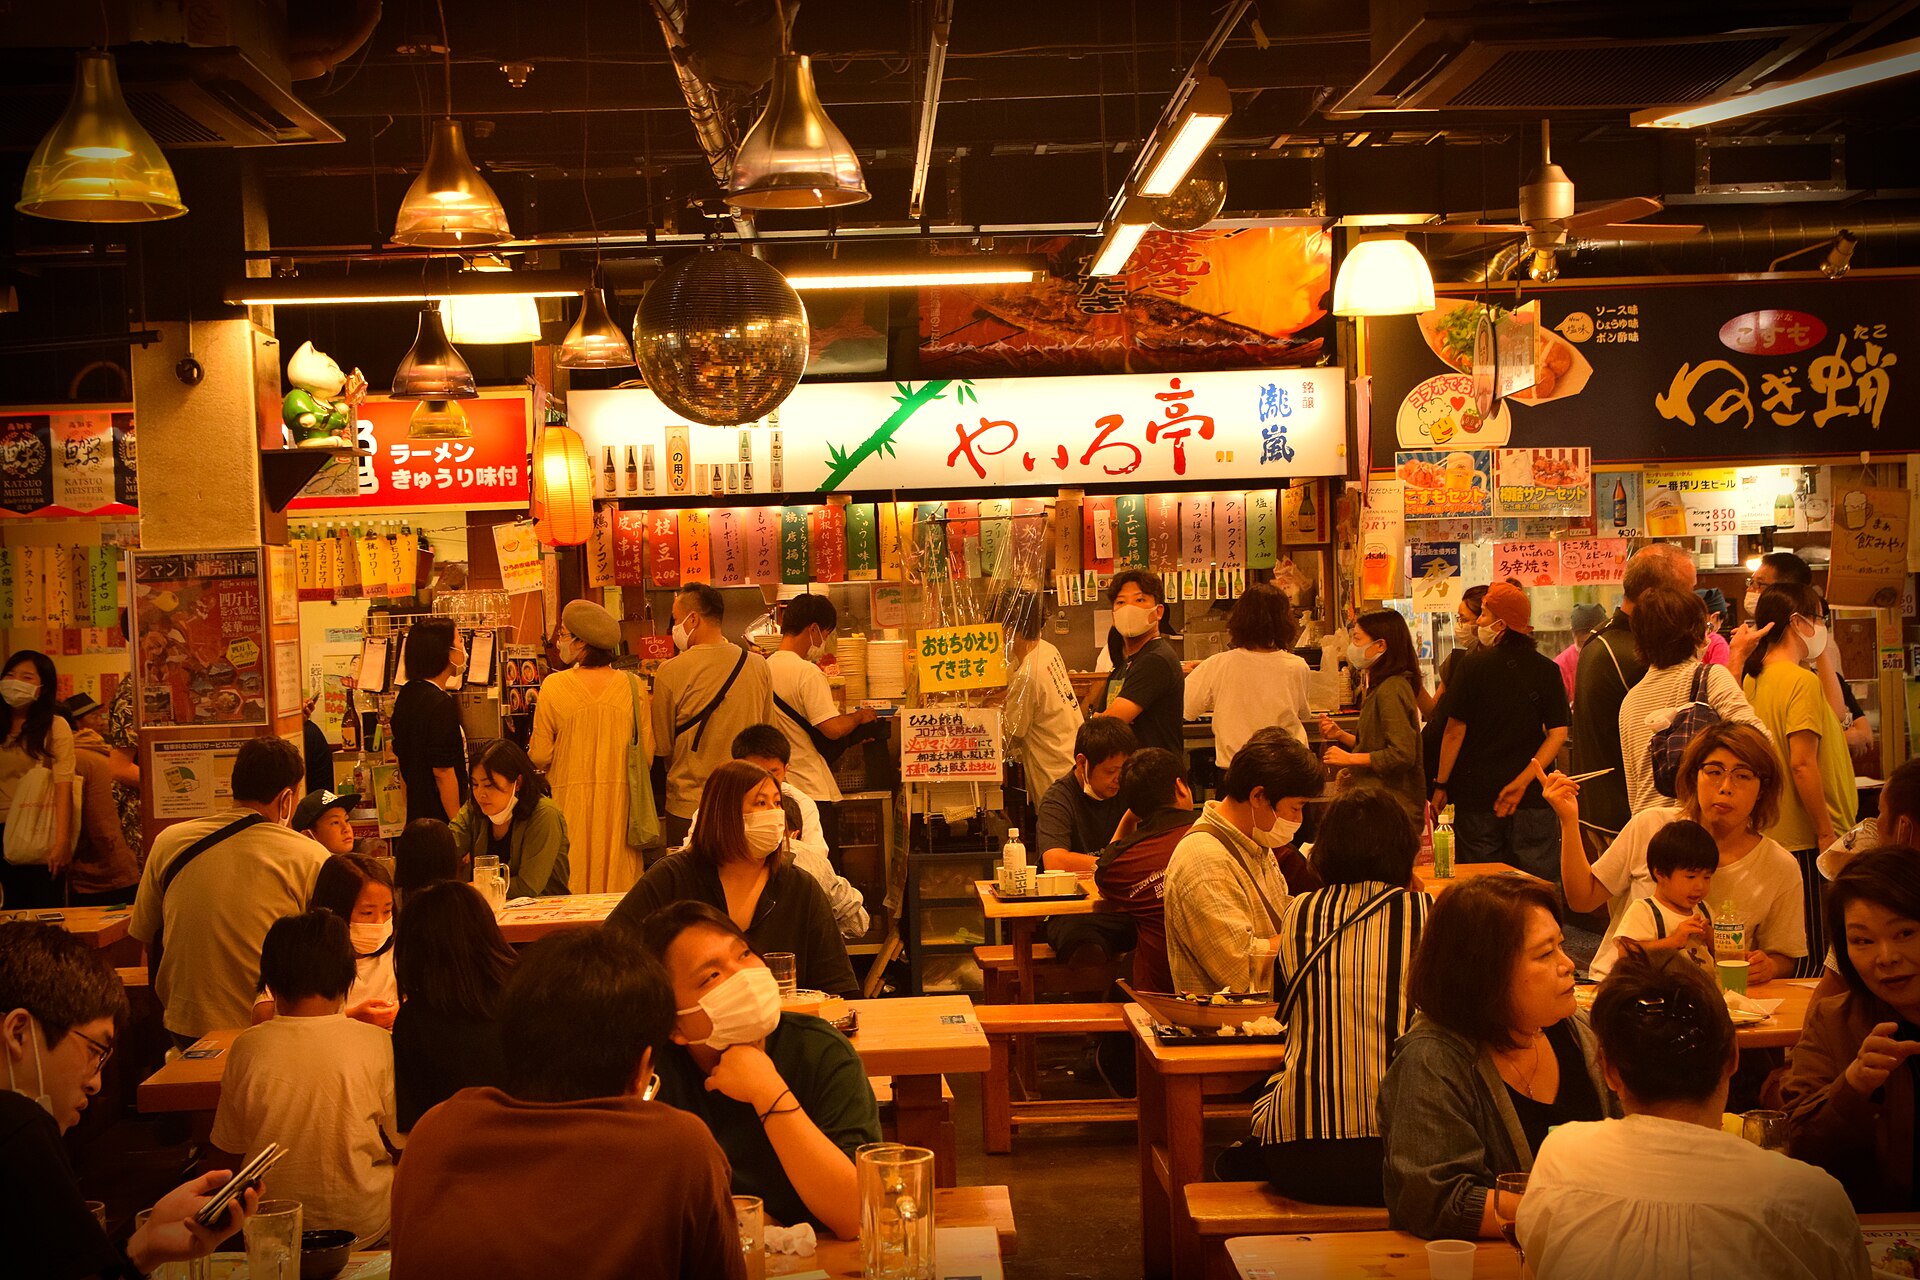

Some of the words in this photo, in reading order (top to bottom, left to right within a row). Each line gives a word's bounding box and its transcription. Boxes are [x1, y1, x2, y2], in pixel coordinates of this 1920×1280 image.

[1595, 305, 1639, 316] ソース味
[1595, 318, 1640, 330] しょうゆ味
[1853, 324, 1888, 340] たこ
[1596, 331, 1640, 343] ポン酢味
[1736, 326, 1810, 349] こすも
[1408, 375, 1476, 410] コラボでお
[947, 377, 1215, 480] やいろ亭
[390, 442, 475, 465] ラーメン
[3, 479, 43, 488] KATSUO
[64, 477, 103, 486] KATSUO
[391, 465, 519, 490] きゅうり味付
[1658, 479, 1736, 492] 一番搾り生ビール
[3, 488, 44, 496] MEISTER
[64, 486, 104, 495] MEISTER
[1404, 487, 1486, 505] こすもセット
[1499, 486, 1586, 503] 樽詰サワーセット
[1711, 509, 1736, 519] 850
[1226, 501, 1237, 560] タレタタキ
[1255, 498, 1267, 549] 塩タタキ
[1712, 520, 1736, 531] 550
[617, 514, 632, 557] 皮串
[653, 518, 674, 563] 枝豆
[687, 512, 702, 562] 焼きそば
[720, 512, 736, 573] マーボー豆腐
[1503, 544, 1536, 553] しあわせ
[1563, 540, 1599, 551] たこ焼き
[136, 559, 256, 579] シマント補完計画
[756, 569, 771, 577] 500
[722, 574, 740, 582] 650
[921, 631, 999, 657] おもちかえり
[930, 657, 988, 682] できます
